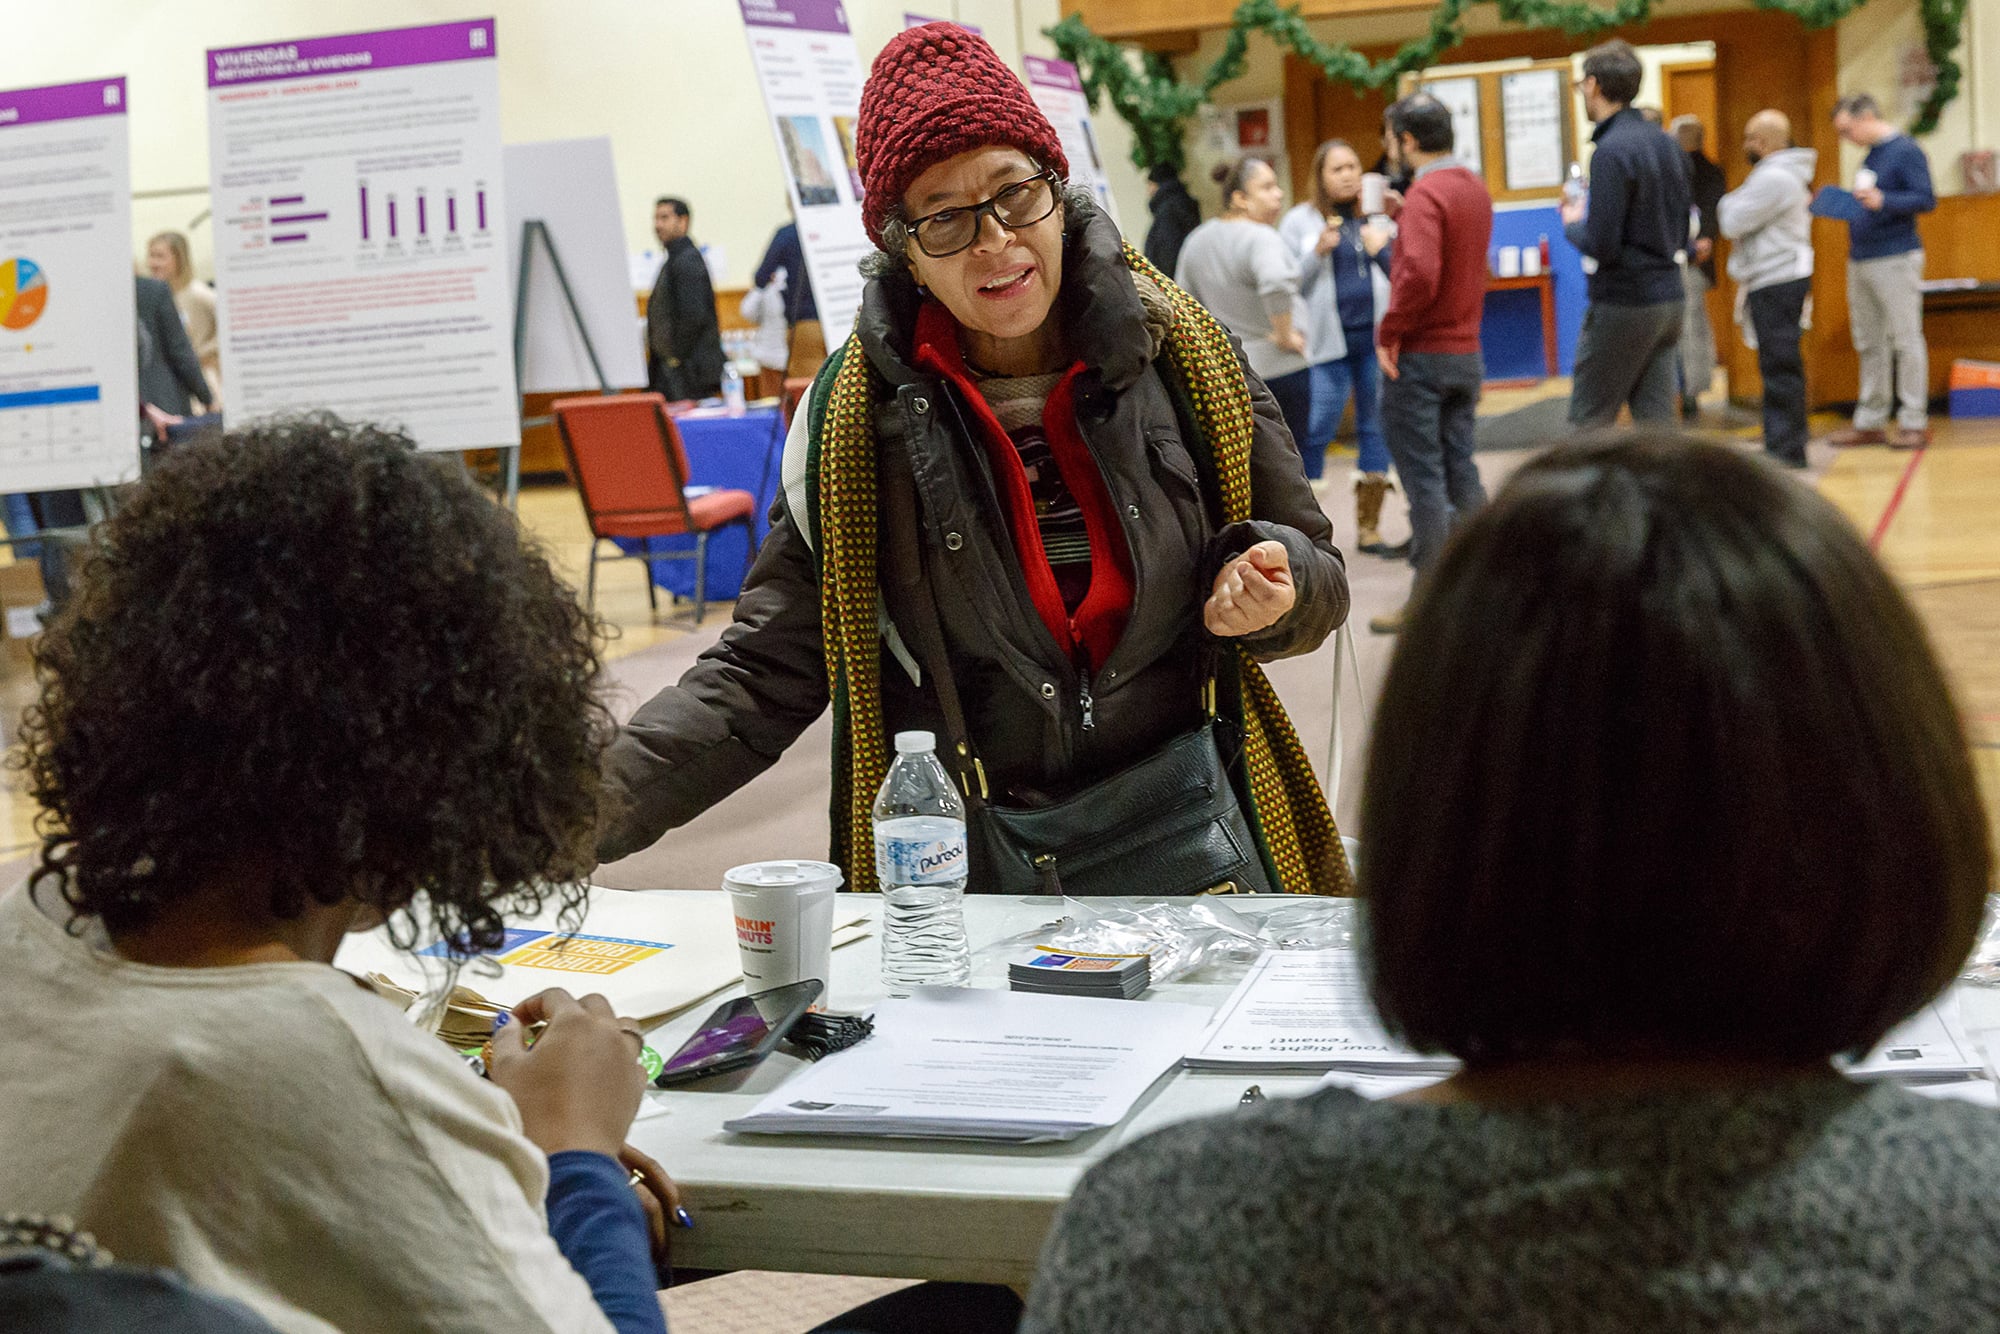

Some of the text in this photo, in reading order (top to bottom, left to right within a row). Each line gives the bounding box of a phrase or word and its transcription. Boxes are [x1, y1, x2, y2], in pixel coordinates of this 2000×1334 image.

[215, 45, 298, 68] VIVIENDAS
[735, 916, 775, 932] NKIN'
[737, 927, 773, 945] NUTS
[520, 953, 623, 973] TENANT
[1269, 1037, 1350, 1045] Tenant!
